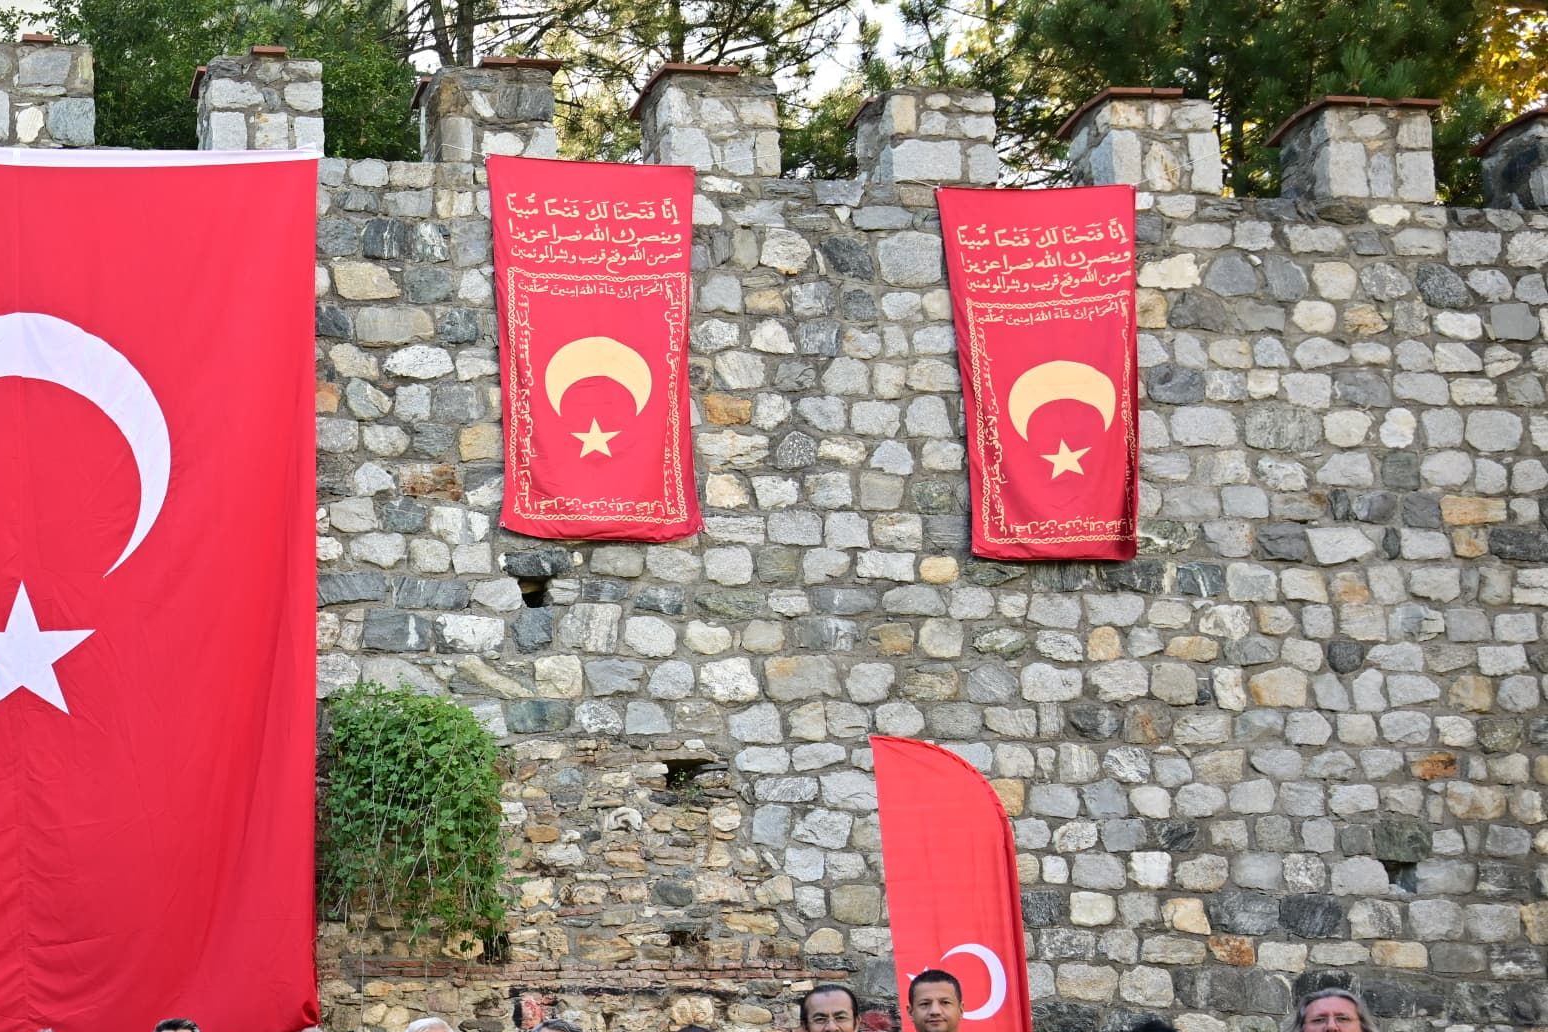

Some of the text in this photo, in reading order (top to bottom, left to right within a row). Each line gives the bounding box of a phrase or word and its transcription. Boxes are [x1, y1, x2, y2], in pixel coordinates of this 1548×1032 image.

[508, 219, 550, 242] عزيزا
[553, 224, 582, 244] نصرا
[585, 224, 610, 242] الله
[628, 247, 645, 261] الله
[960, 252, 1000, 274] عزيزا
[1001, 252, 1034, 274] نصرا
[1036, 250, 1060, 268] الله
[1081, 269, 1097, 283] الله
